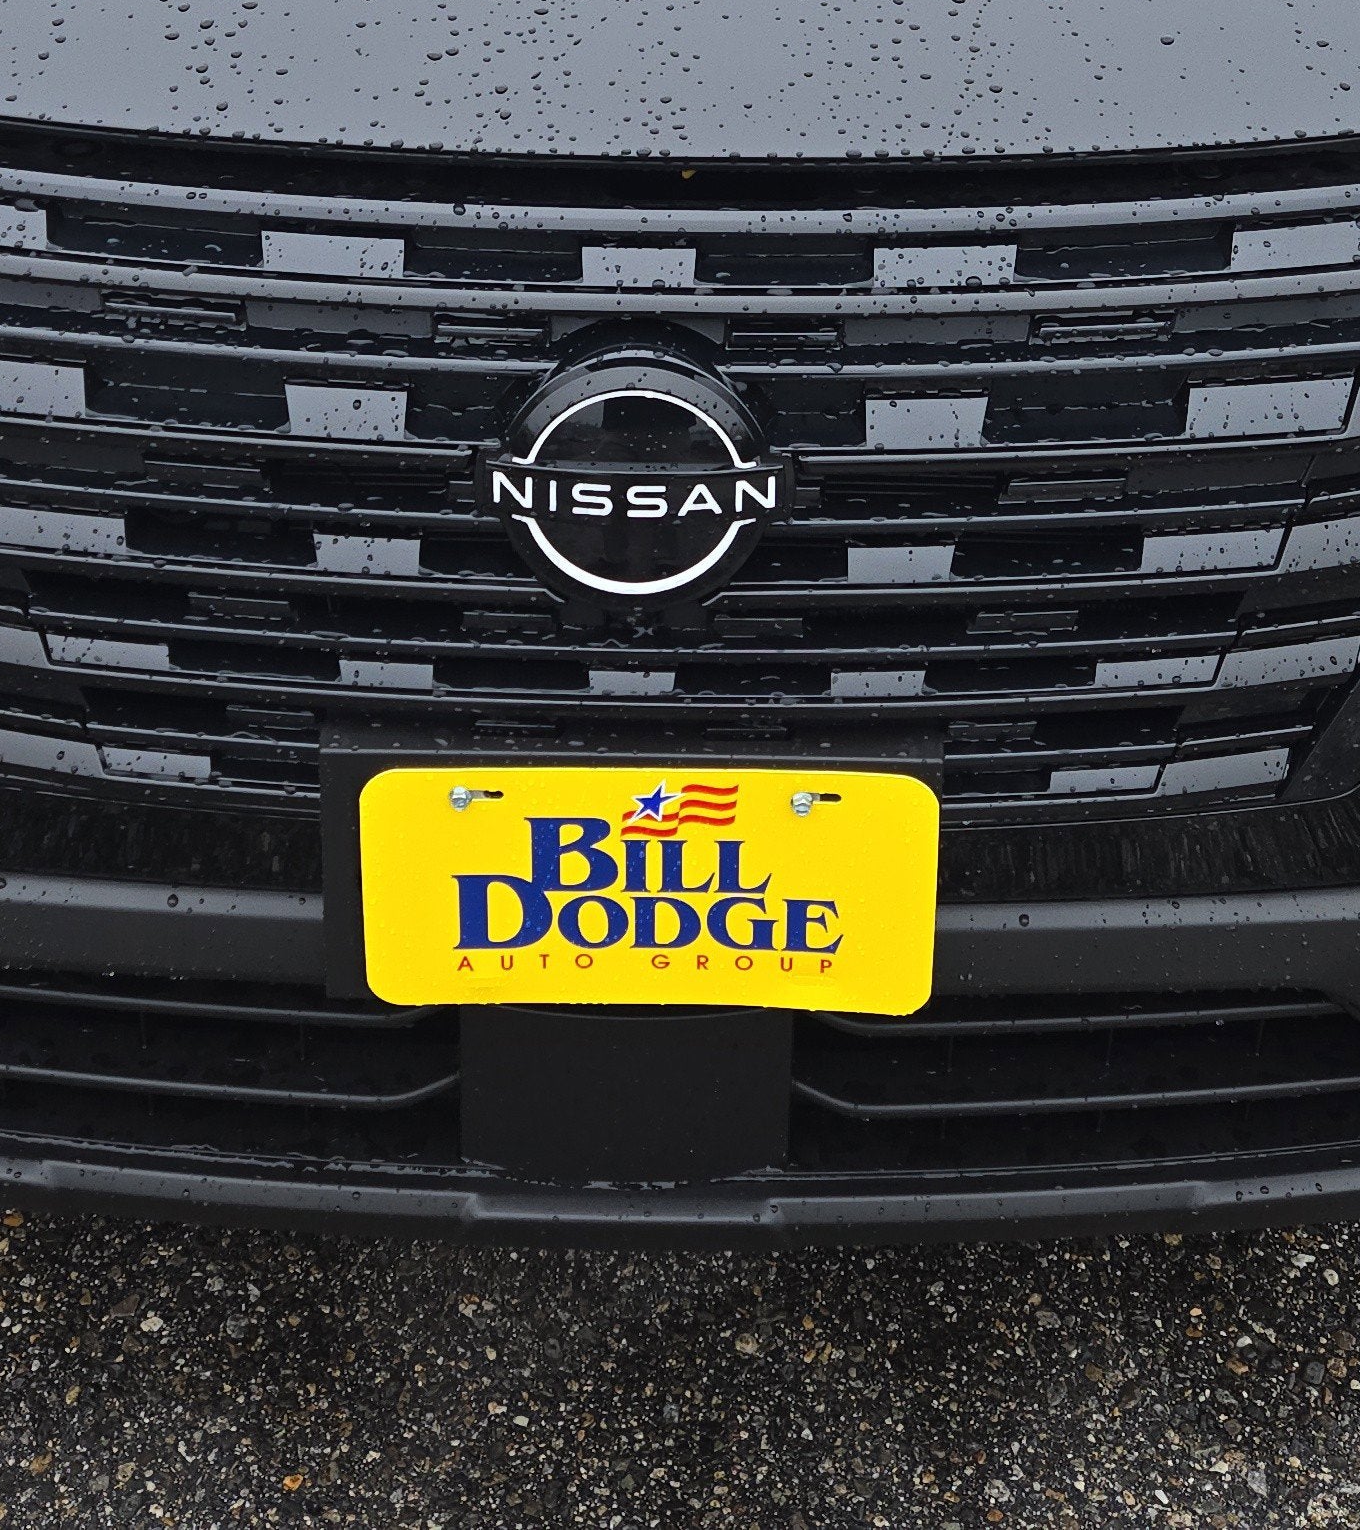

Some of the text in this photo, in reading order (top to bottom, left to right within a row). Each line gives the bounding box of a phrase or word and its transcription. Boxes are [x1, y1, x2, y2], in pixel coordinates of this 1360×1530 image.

[492, 470, 776, 518] NISSAN
[524, 816, 773, 894] BILL
[451, 874, 844, 955] DODGE
[456, 953, 834, 974] AUTO GROUP
